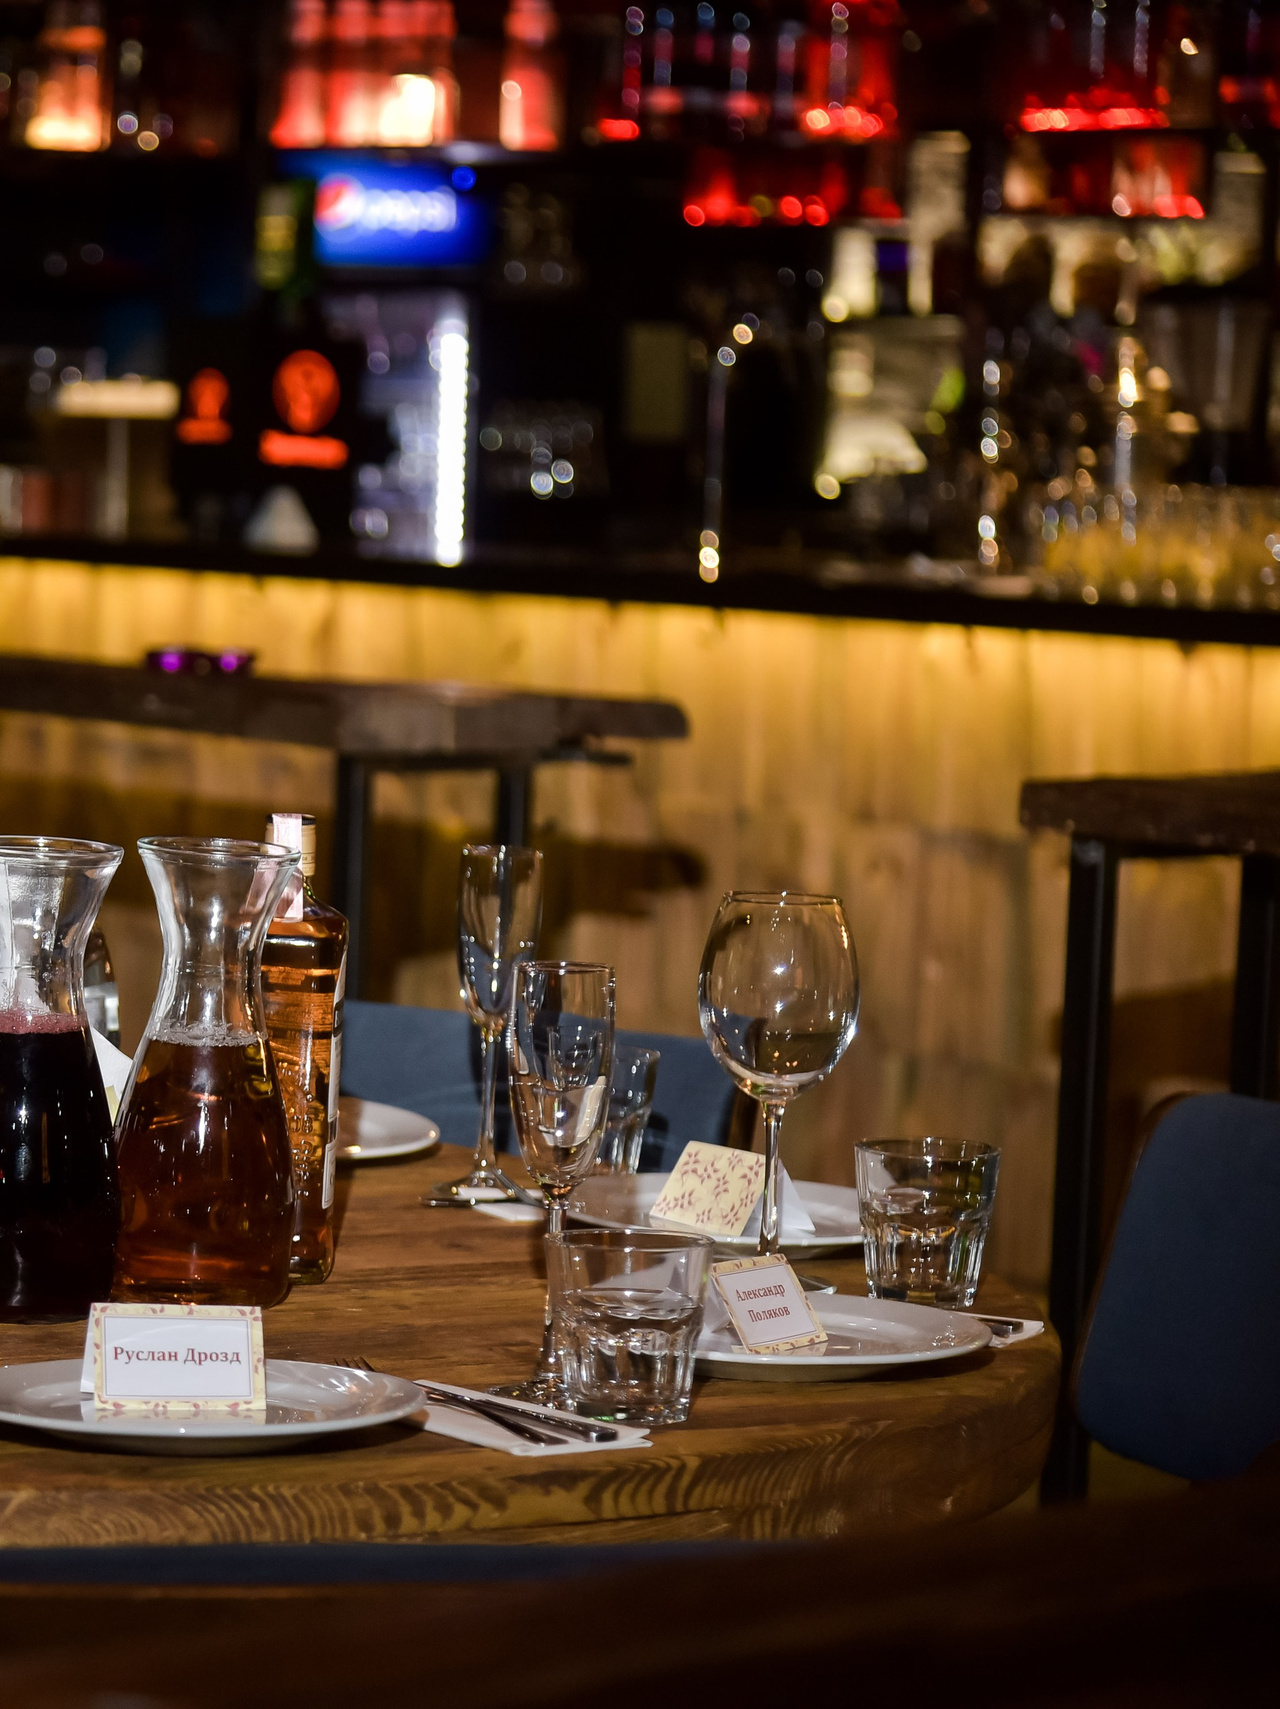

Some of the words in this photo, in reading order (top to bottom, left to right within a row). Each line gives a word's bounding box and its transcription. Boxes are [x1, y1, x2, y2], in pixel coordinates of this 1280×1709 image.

[735, 1284, 786, 1301] Александр
[748, 1306, 791, 1322] Поляков
[113, 1346, 179, 1365] Руслан
[184, 1348, 242, 1366] Дрозд
